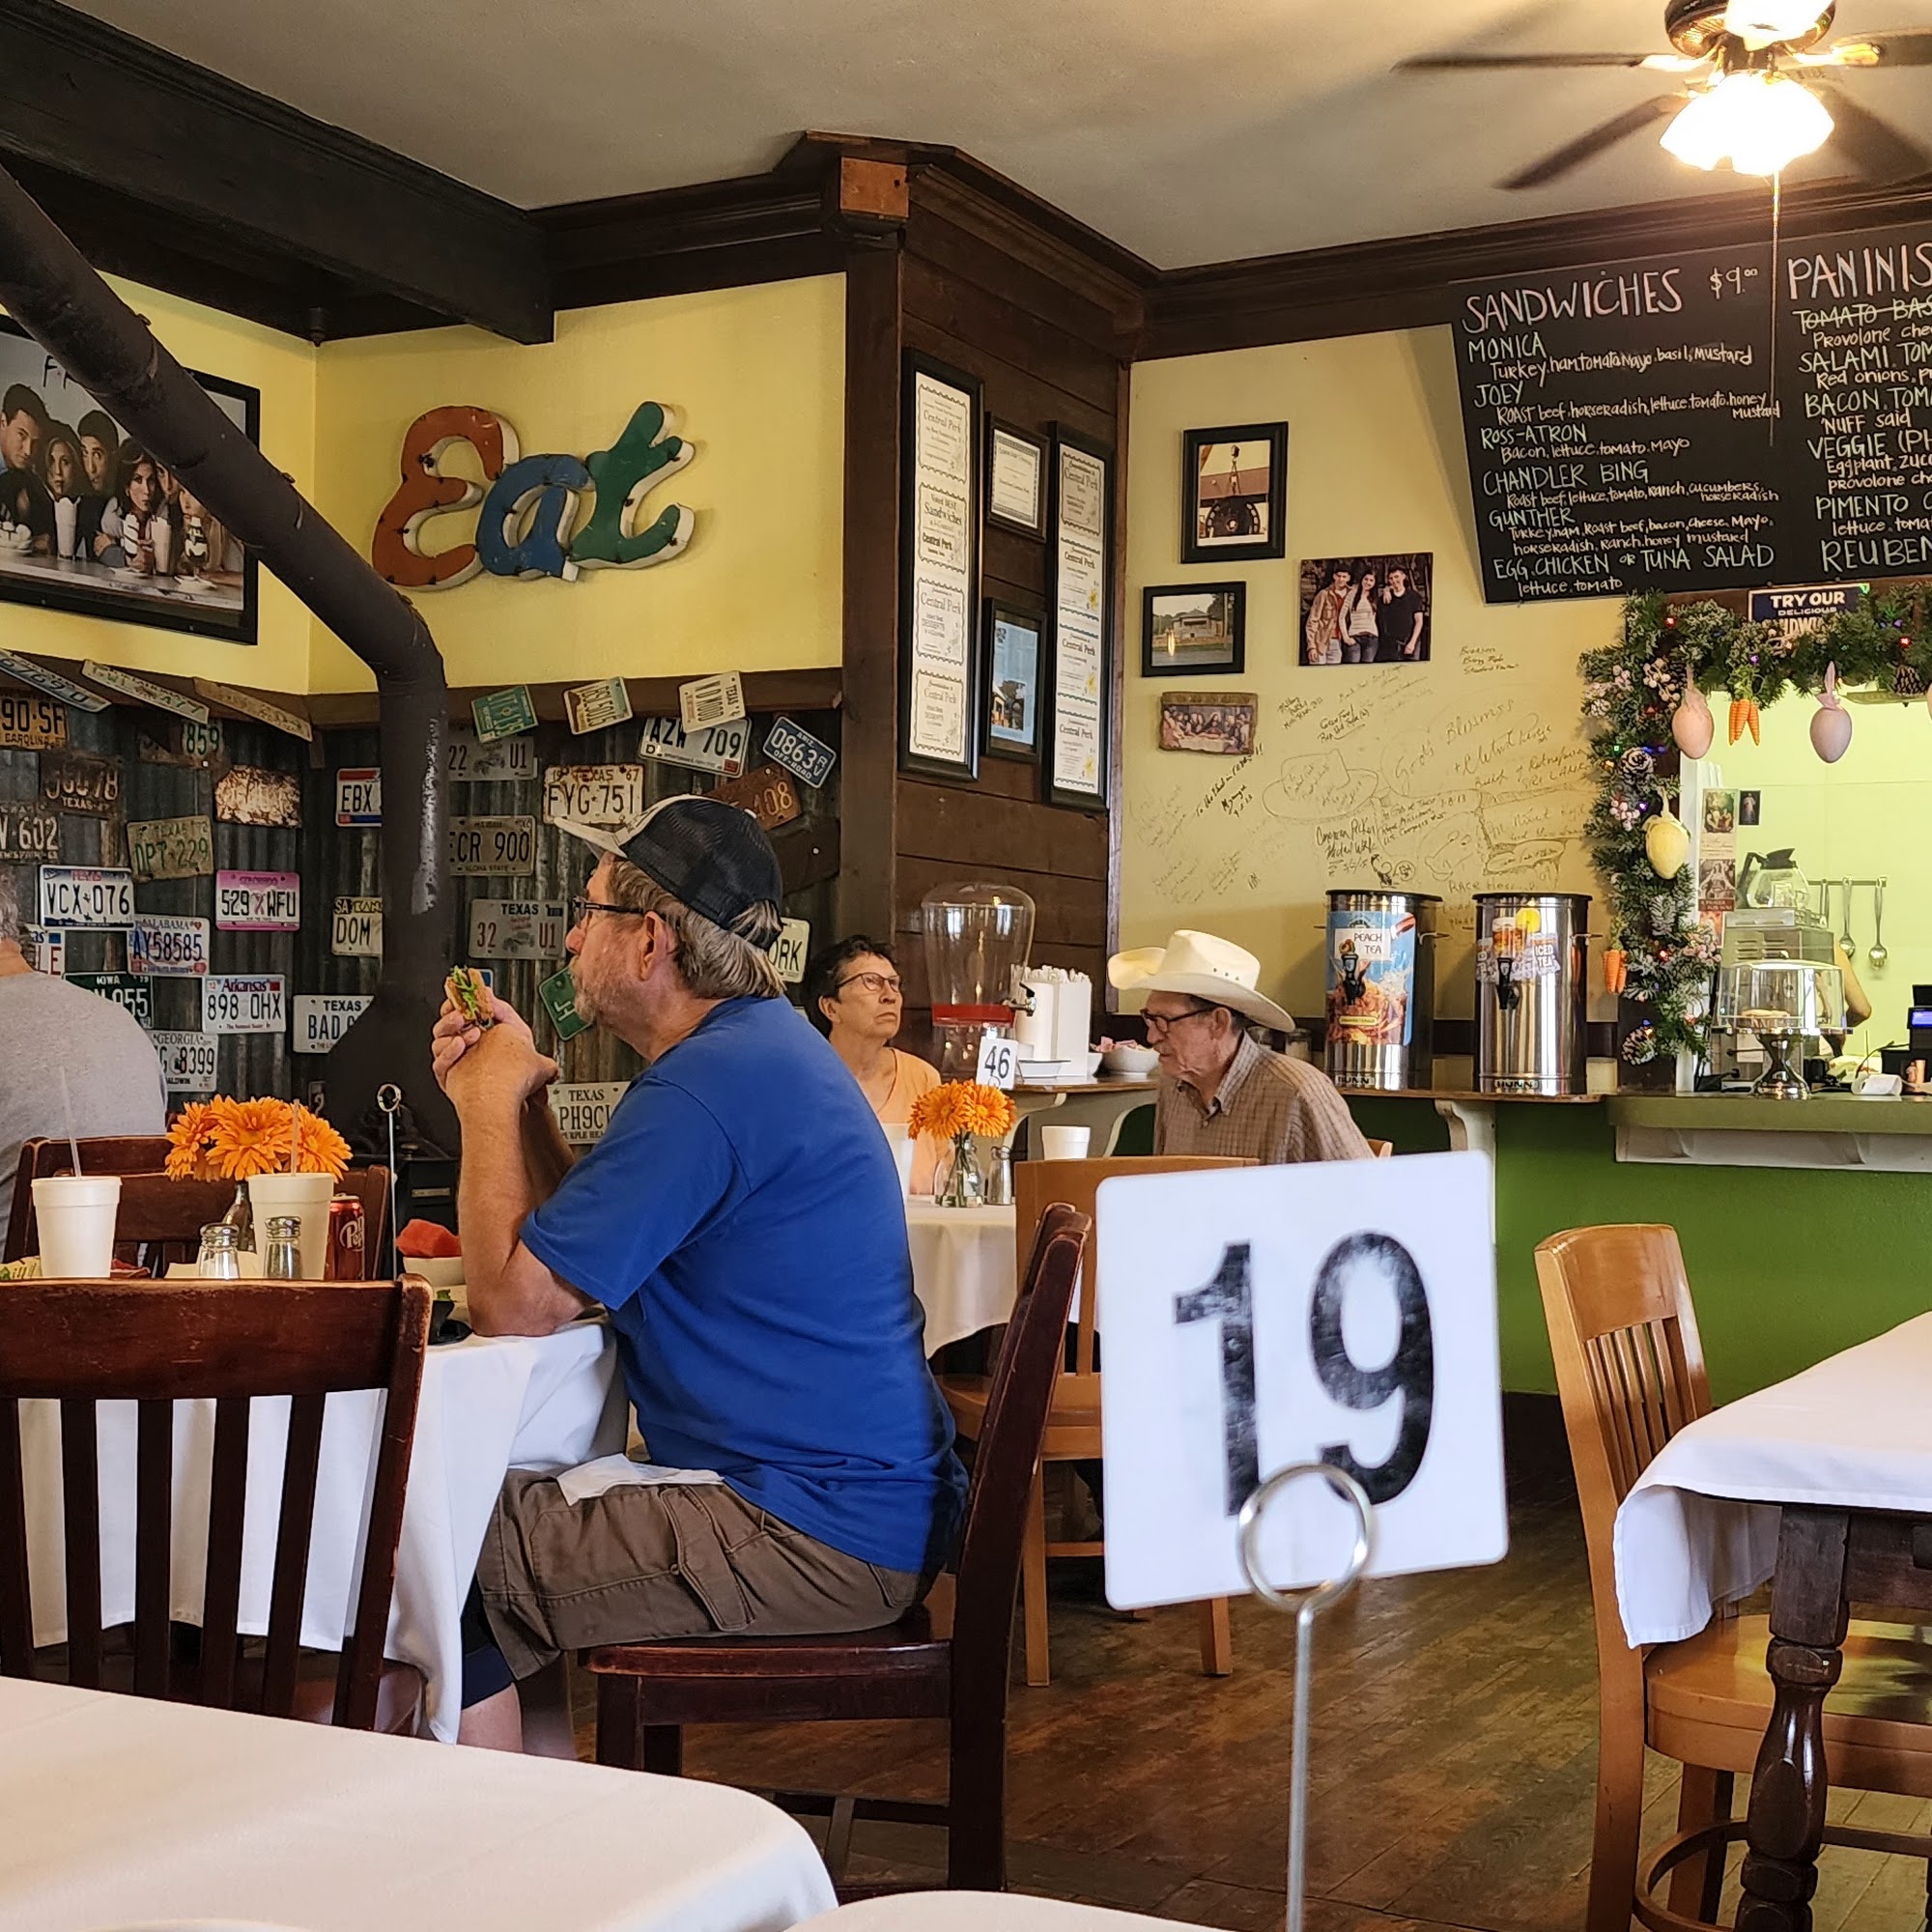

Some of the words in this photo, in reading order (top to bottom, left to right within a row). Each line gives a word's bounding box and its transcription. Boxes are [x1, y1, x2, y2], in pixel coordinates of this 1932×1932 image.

[1788, 242, 1932, 299] PANINIS
[1463, 269, 1683, 333] SANDWICHES
[1792, 303, 1878, 334] TOMATO
[1901, 322, 1932, 338] che
[1468, 331, 1547, 363] MONICA
[1816, 369, 1849, 390] Red
[1473, 382, 1523, 410] JOEY
[1886, 386, 1932, 410] TOM
[1875, 407, 1912, 427] said
[1806, 433, 1887, 459] VEGGIE
[1483, 464, 1588, 496] CHANDLER
[1600, 460, 1649, 484] BING
[372, 401, 695, 591] Eat
[1815, 494, 1909, 520] PIMENTO
[1489, 507, 1576, 531] GUNTHER
[1894, 516, 1932, 531] toma
[1534, 554, 1610, 577] CHICKEN
[1640, 548, 1690, 573] TUNA
[1703, 545, 1775, 570] SALAD
[1821, 536, 1932, 572] REUBEN
[1770, 593, 1807, 609] TRY
[1809, 591, 1845, 606] OUR
[703, 728, 741, 758] 709
[448, 745, 467, 771] 22
[774, 749, 812, 780] OFF-ROAD
[342, 784, 373, 813] EBX
[548, 784, 590, 816] FYG
[599, 784, 634, 814] 751
[495, 832, 530, 862] 900
[46, 884, 82, 915] VCX
[93, 885, 130, 916] 076
[221, 889, 249, 917] 529
[267, 889, 297, 917] WFU
[501, 903, 539, 916] TEXAS
[336, 917, 371, 946] DOM
[477, 923, 497, 948] 32
[1353, 932, 1382, 942] PEACH
[1364, 944, 1382, 954] TEA
[1538, 955, 1553, 967] TEA
[97, 975, 121, 985] IOWA
[220, 978, 268, 993] Arkansas
[207, 994, 240, 1020] 898
[323, 1000, 361, 1011] TEXAS
[156, 1034, 200, 1045] GEORGIA
[308, 1014, 340, 1039] BAD
[180, 1047, 214, 1075] 8399
[983, 1044, 1011, 1079] 46
[568, 1089, 605, 1101] TEXAS
[1174, 1230, 1435, 1517] 19
